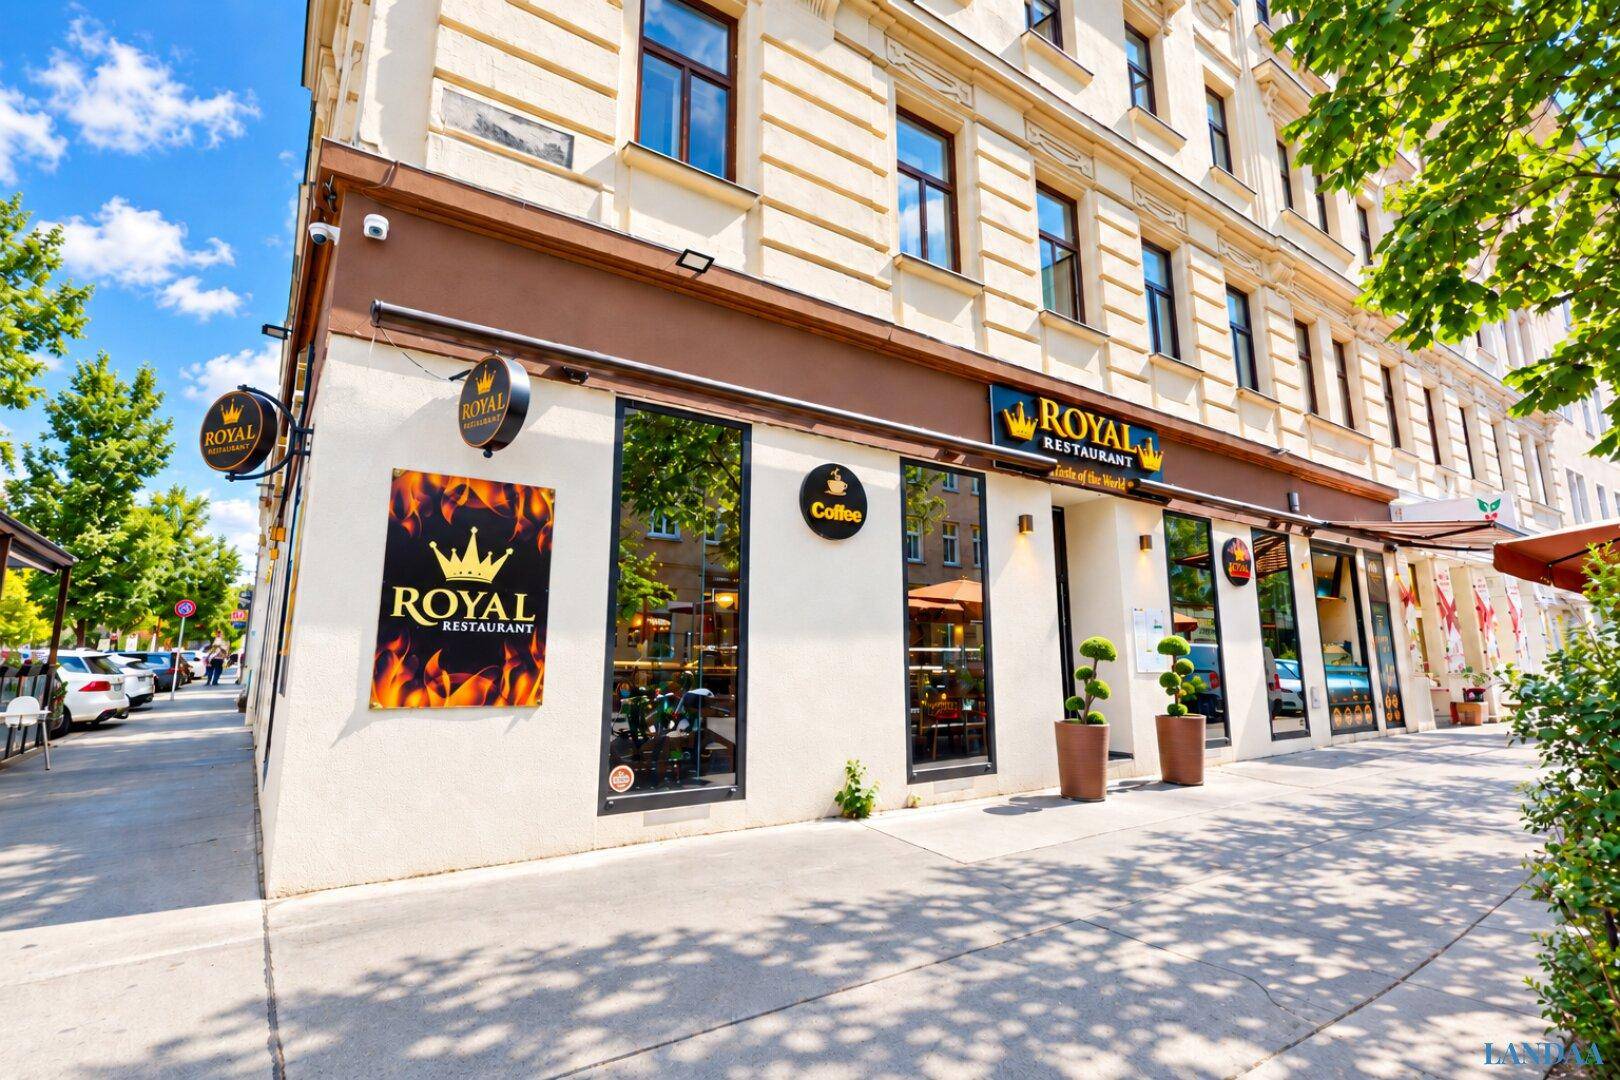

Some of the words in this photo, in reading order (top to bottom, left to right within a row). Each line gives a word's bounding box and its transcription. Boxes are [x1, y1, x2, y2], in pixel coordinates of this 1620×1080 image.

[462, 392, 505, 420] ROYAL
[205, 425, 256, 446] ROYAL
[1039, 397, 1138, 454] ROYAL
[1043, 436, 1133, 468] RESTAURANT
[1078, 469, 1087, 485] of
[1088, 470, 1101, 485] the
[1102, 474, 1126, 490] World
[811, 501, 863, 523] Coffee
[390, 586, 536, 627] ROYAL
[442, 620, 534, 634] RESTAURANT
